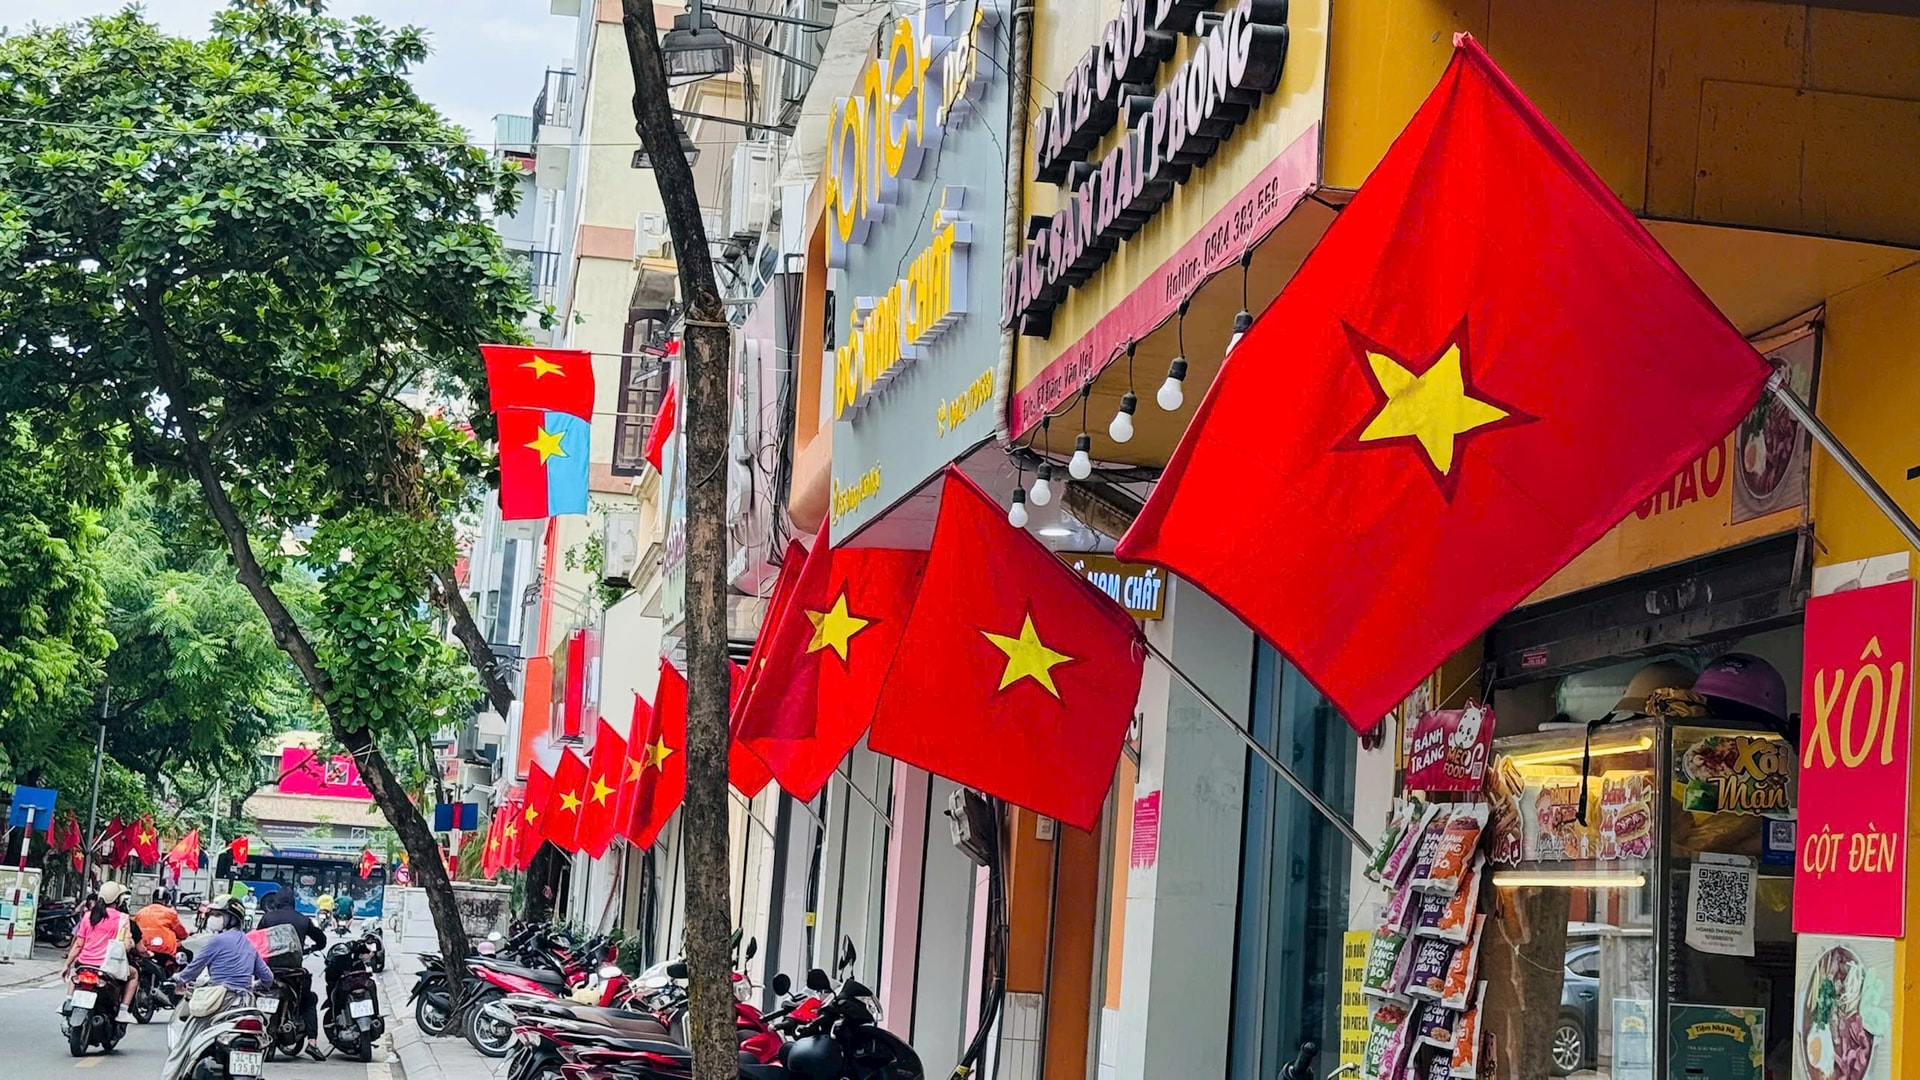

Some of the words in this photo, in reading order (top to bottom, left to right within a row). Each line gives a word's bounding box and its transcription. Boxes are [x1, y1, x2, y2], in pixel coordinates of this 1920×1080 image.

[1204, 220, 1231, 269] 0984
[1123, 567, 1162, 612] CHẤT
[1803, 635, 1904, 769] XÔI
[1413, 727, 1444, 755] BÁNH
[1733, 736, 1790, 780] Xôi
[1707, 774, 1789, 816] Mặn
[1803, 823, 1845, 880] CỘT
[1848, 822, 1898, 873] ĐÈN
